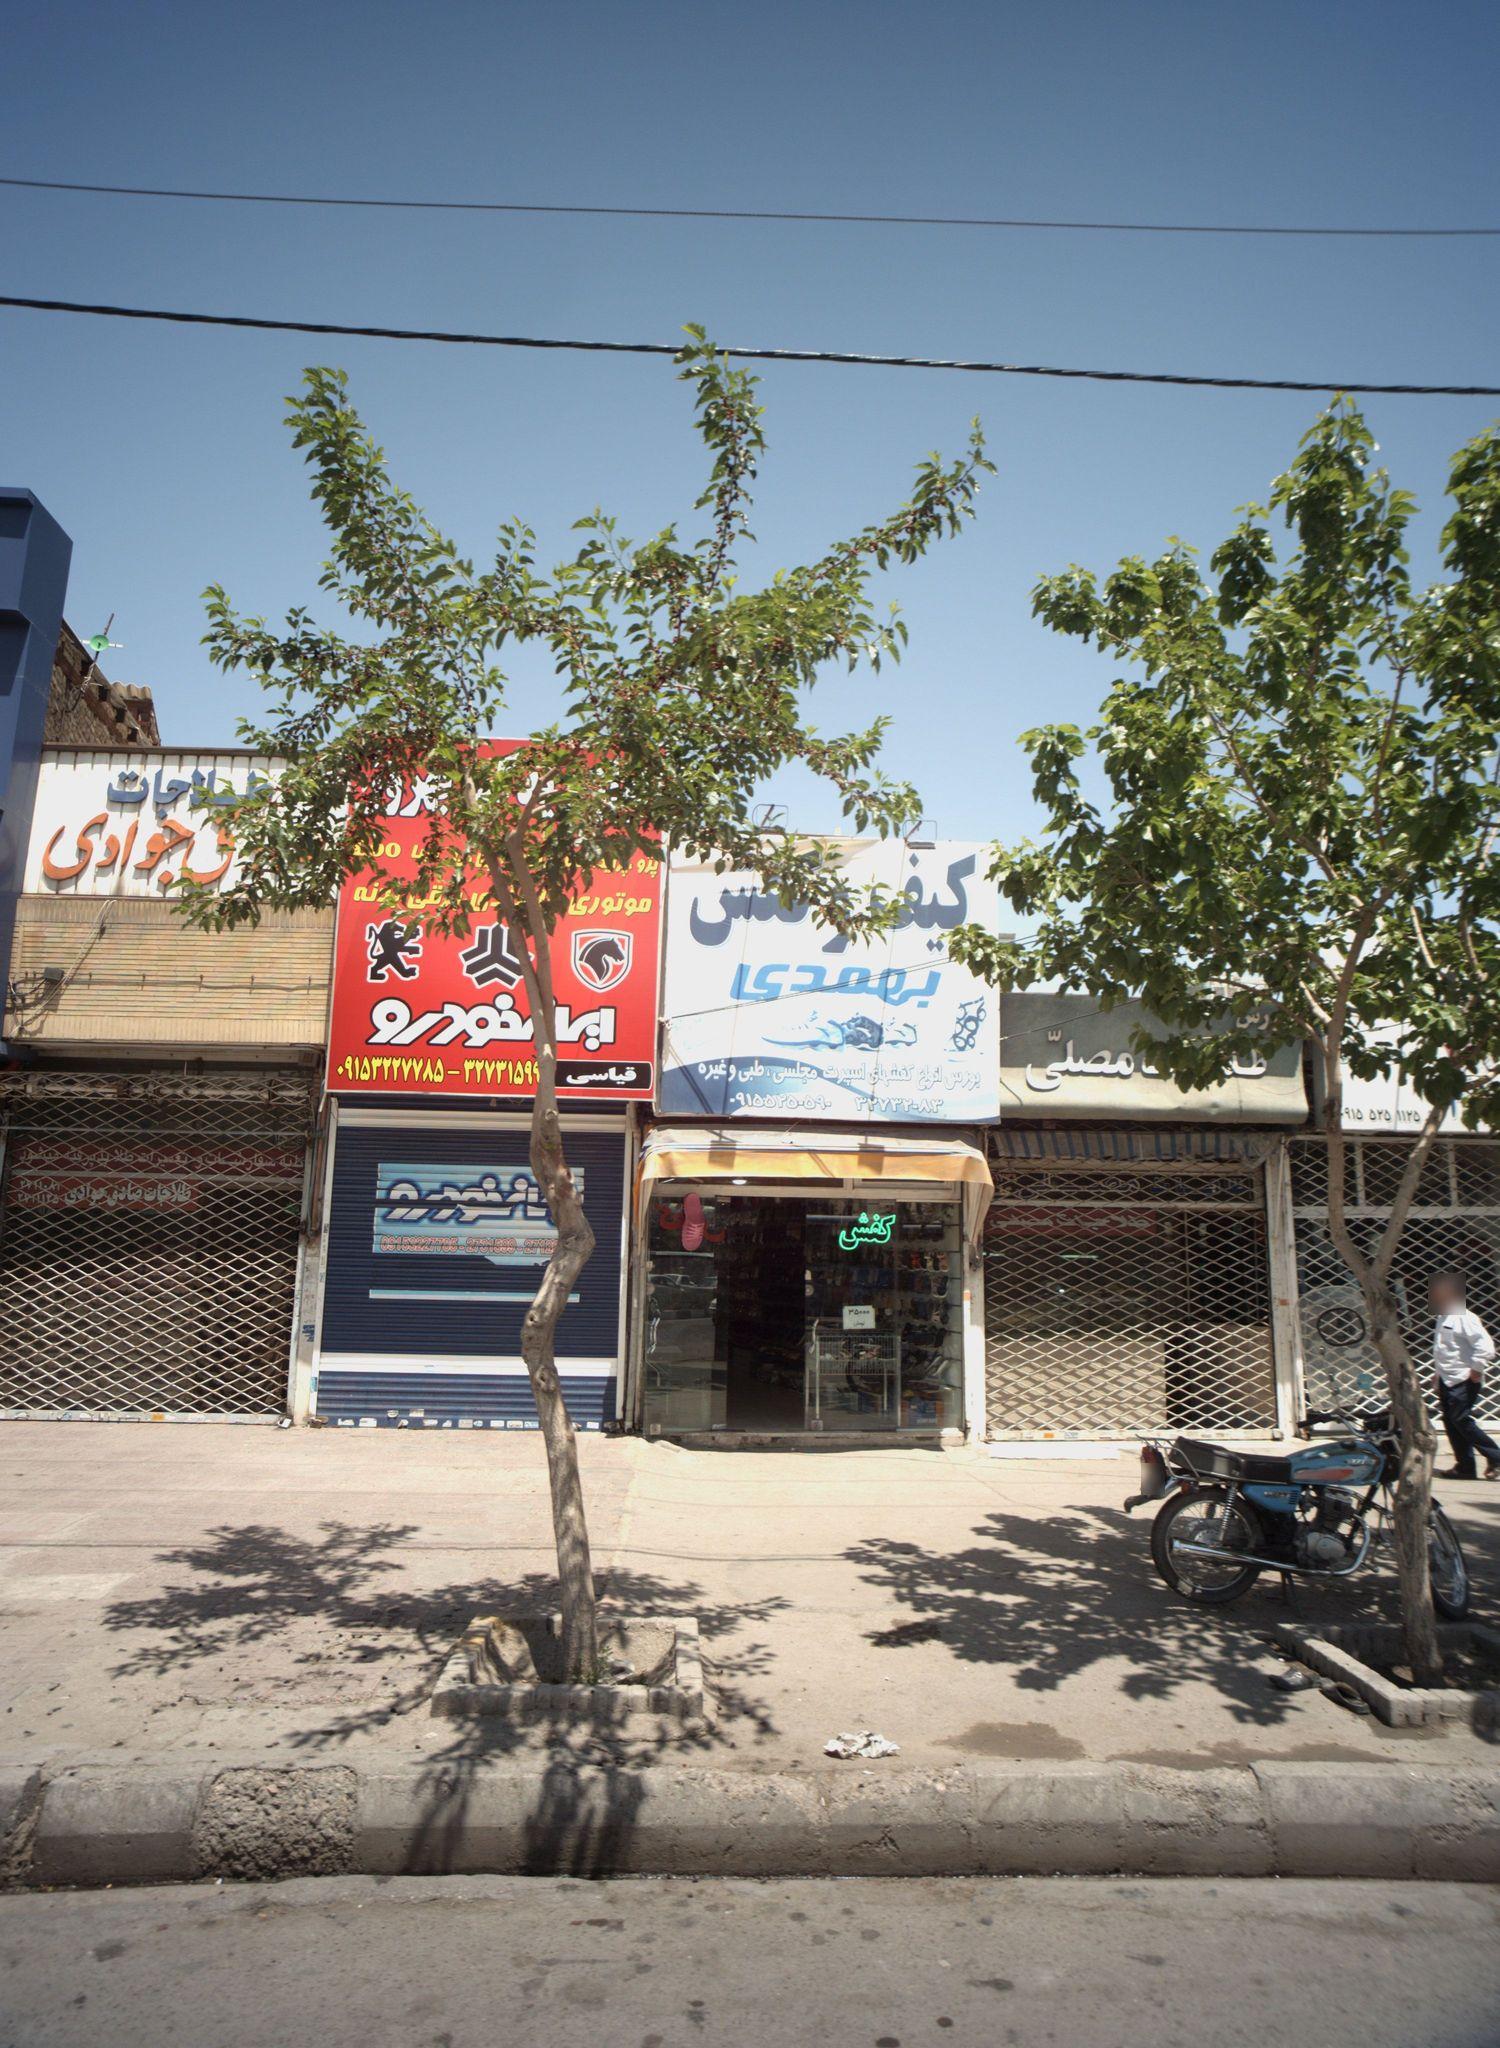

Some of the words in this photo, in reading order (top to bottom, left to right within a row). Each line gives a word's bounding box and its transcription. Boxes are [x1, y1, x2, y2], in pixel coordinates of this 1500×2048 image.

[42, 813, 194, 886] جوادی
[568, 892, 652, 916] موتوری
[566, 1066, 638, 1085] قیاسی
[738, 1059, 765, 1082] طبی
[917, 1064, 943, 1091] انواع
[944, 1071, 981, 1091] بورس
[838, 1211, 897, 1250] کفش
